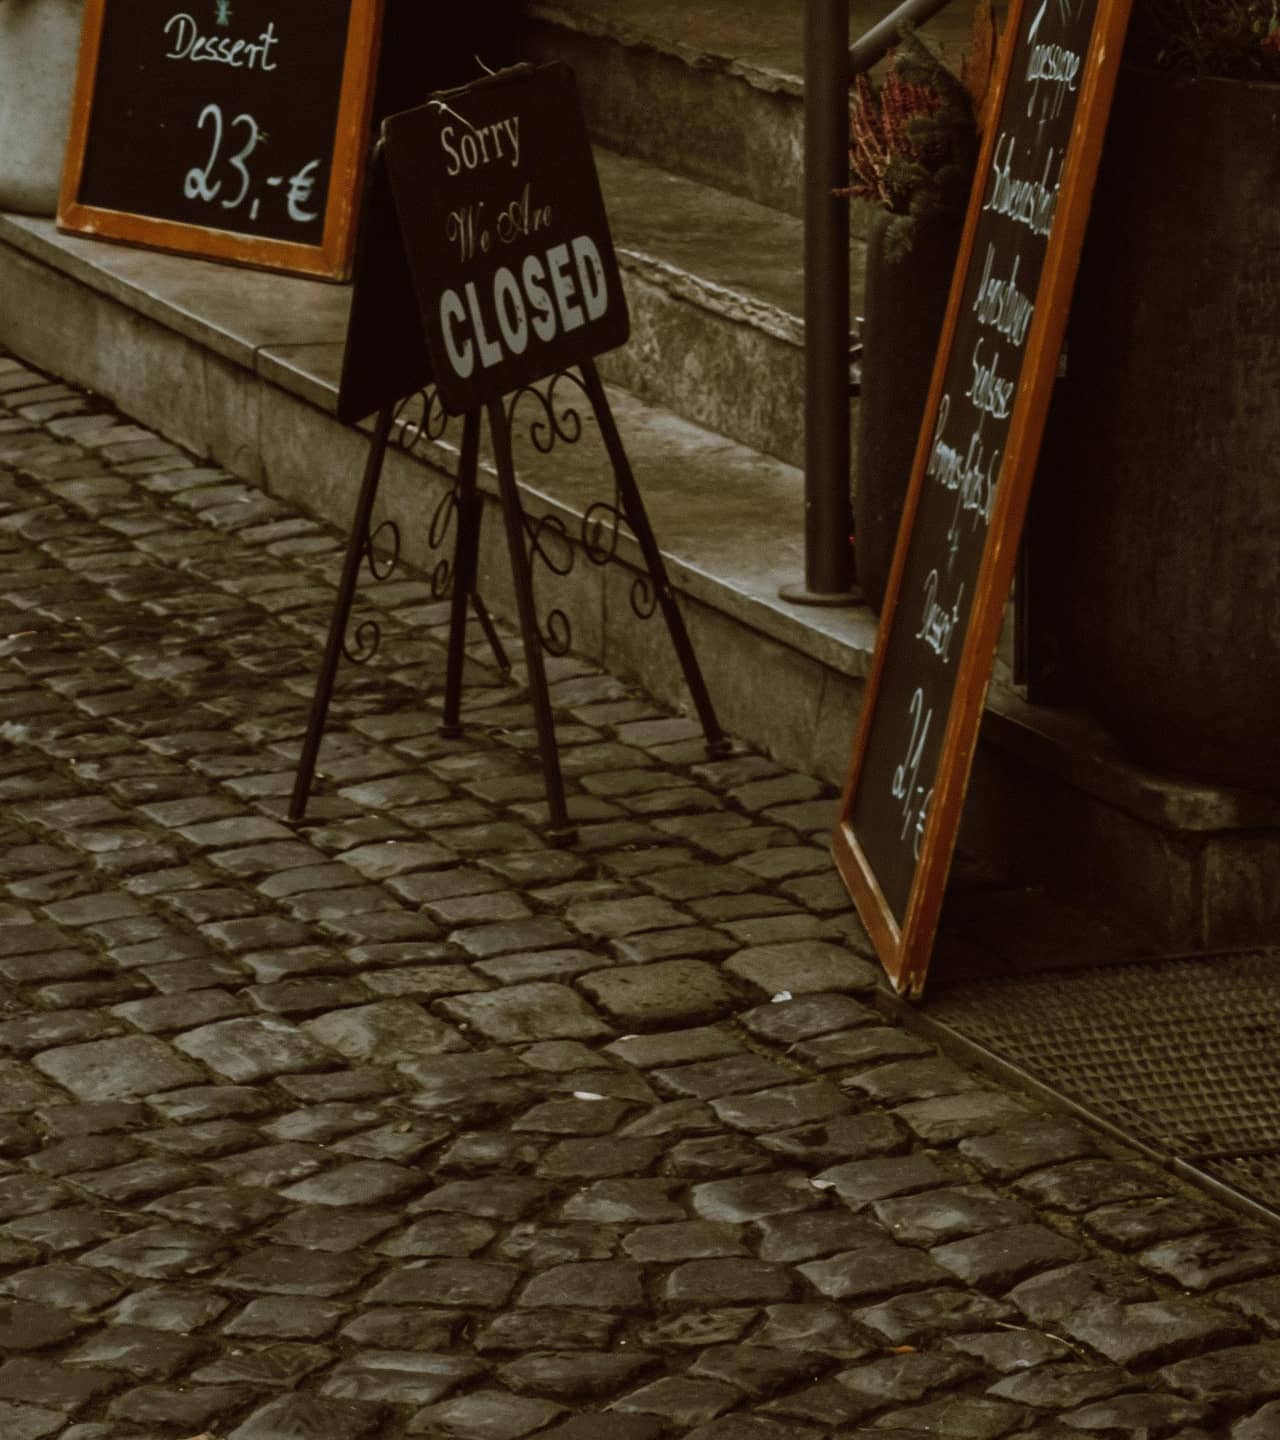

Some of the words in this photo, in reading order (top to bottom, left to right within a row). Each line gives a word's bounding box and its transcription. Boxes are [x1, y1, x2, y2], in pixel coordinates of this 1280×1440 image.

[164, 12, 280, 73] Dessert
[440, 115, 520, 176] Sorry
[444, 199, 490, 264] We
[439, 234, 609, 379] CLOSED
